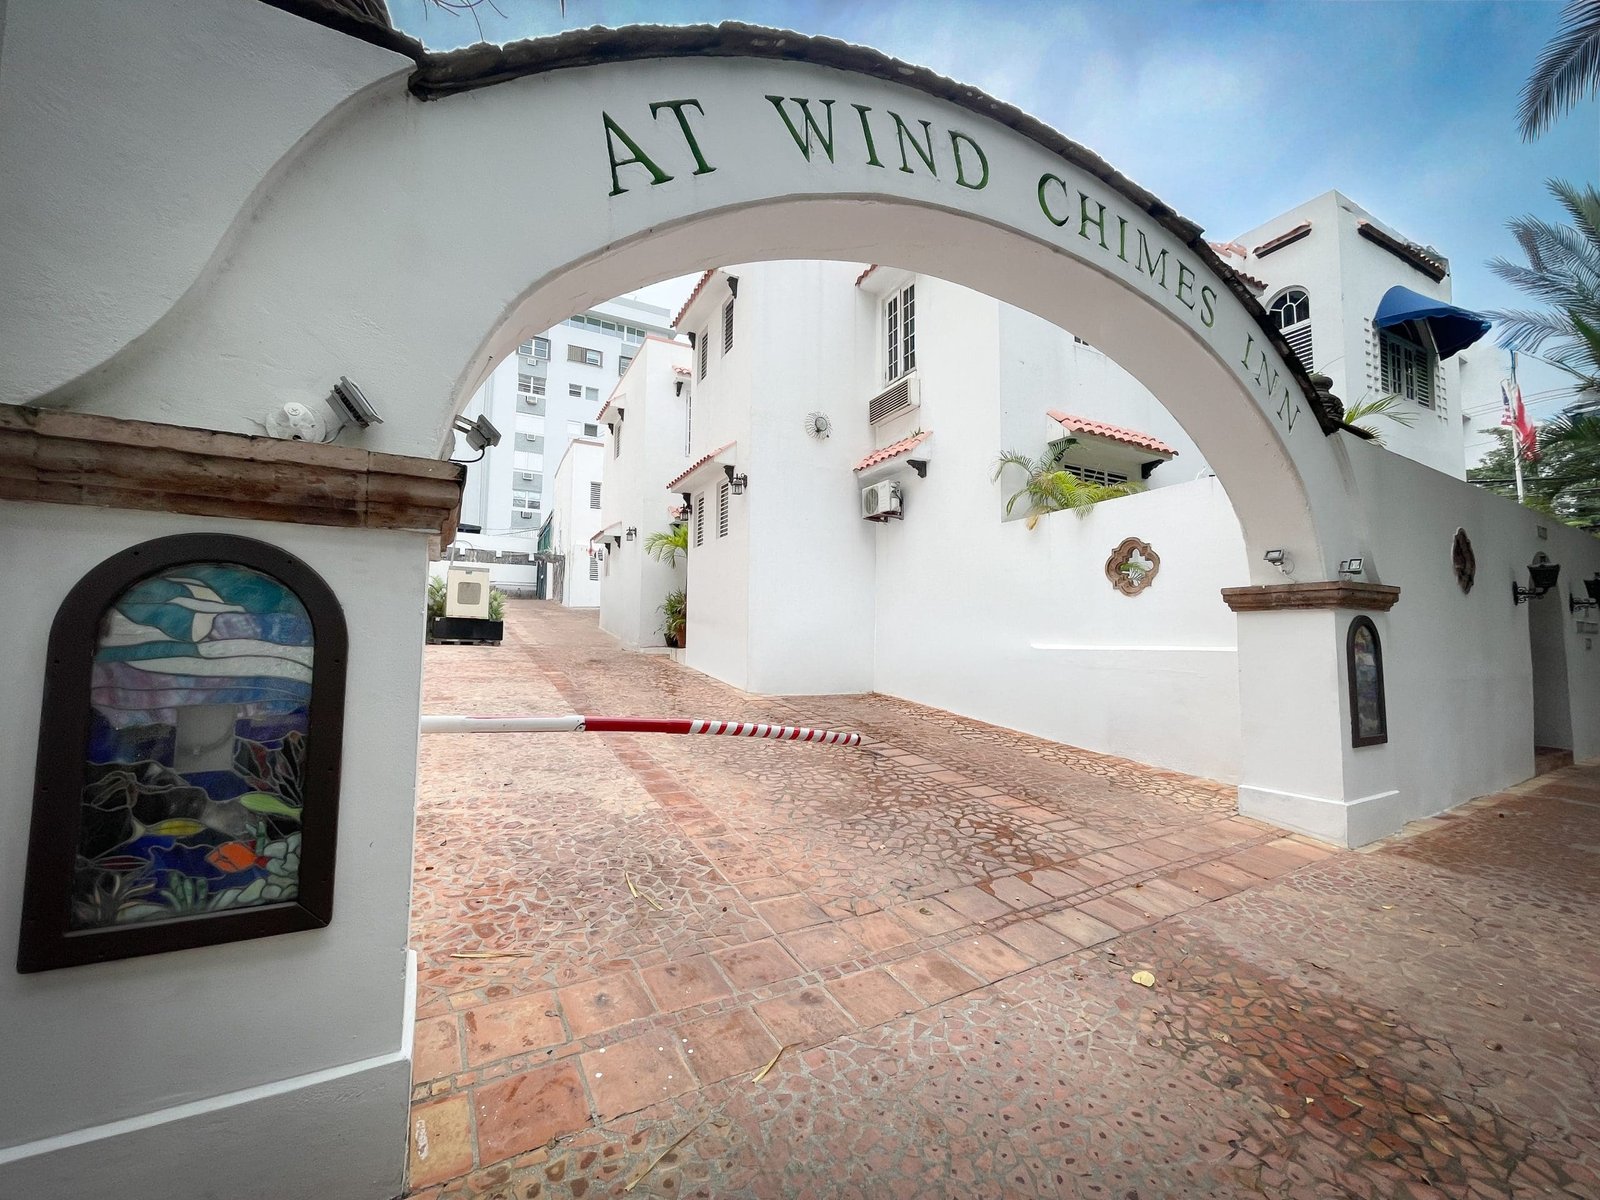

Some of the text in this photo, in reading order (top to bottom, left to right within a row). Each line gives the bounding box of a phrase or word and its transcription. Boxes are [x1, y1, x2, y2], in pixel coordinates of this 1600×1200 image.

[602, 94, 1301, 434] AT WIND CHIMES INN
